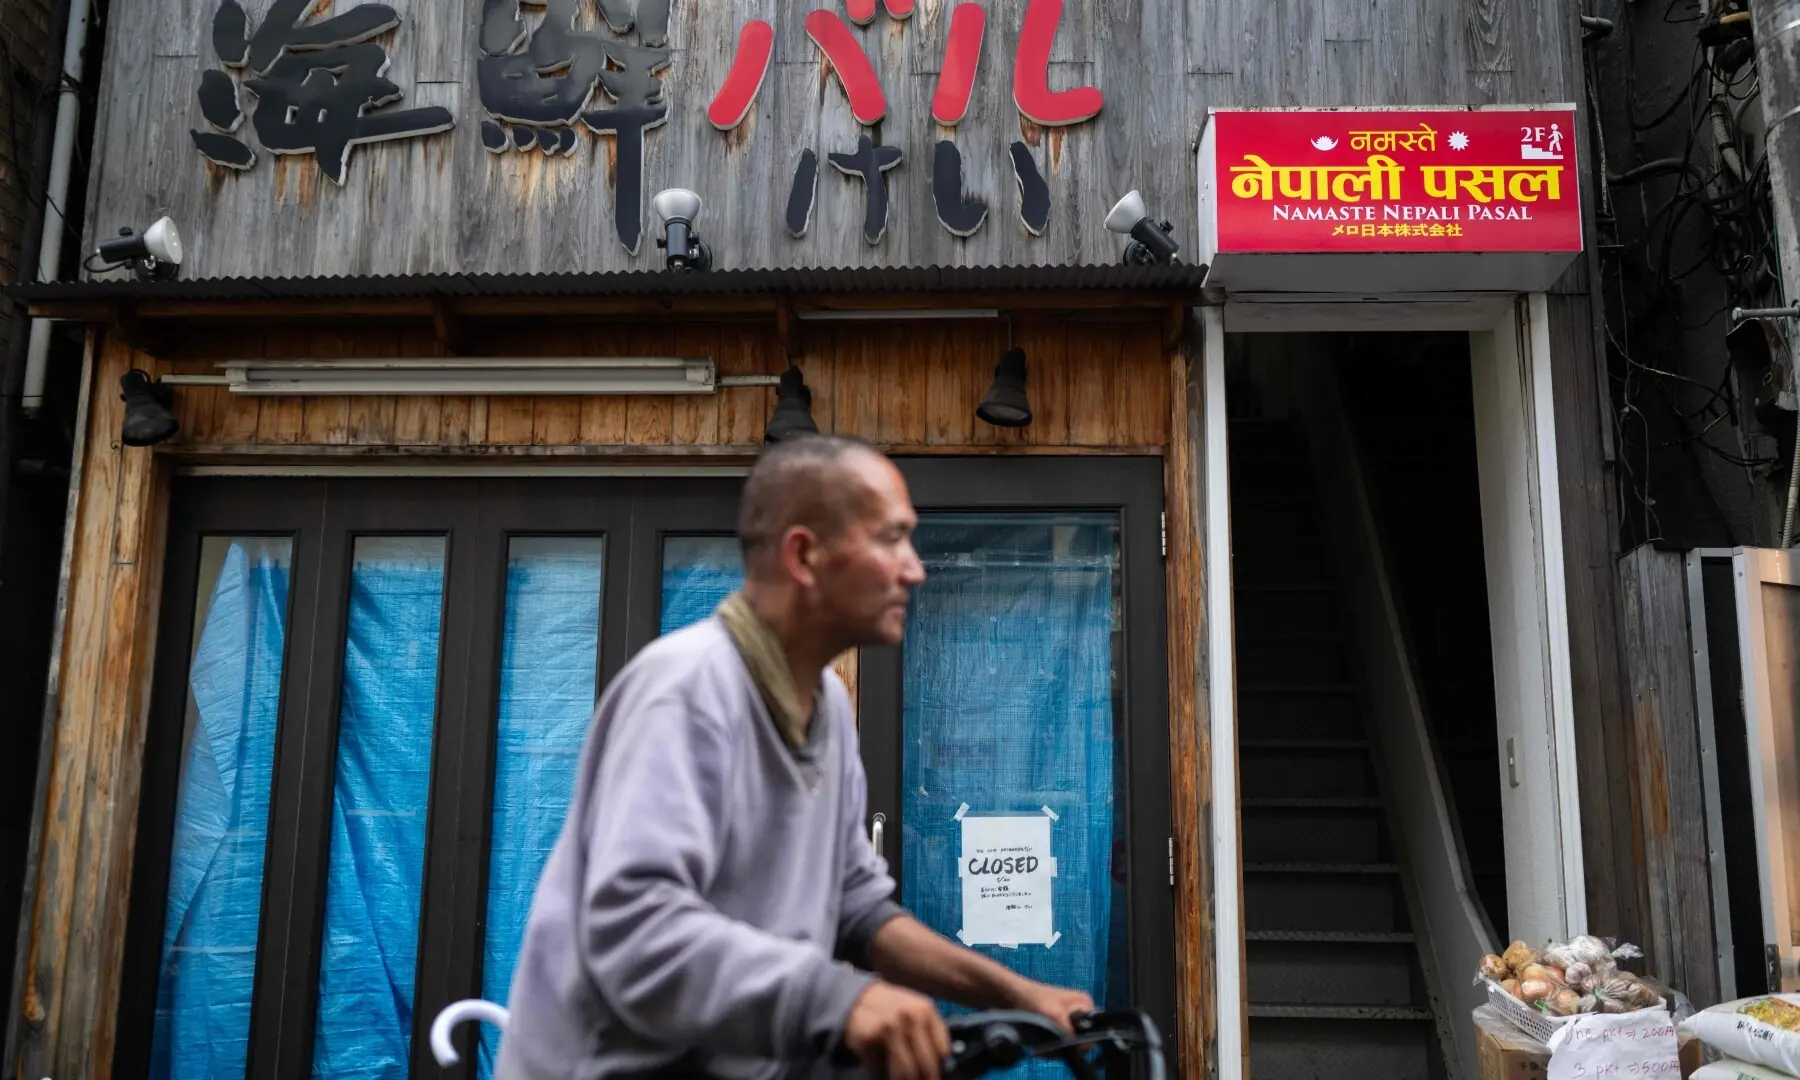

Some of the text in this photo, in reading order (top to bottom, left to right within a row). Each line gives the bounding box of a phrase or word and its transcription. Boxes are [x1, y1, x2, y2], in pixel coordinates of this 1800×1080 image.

[1348, 122, 1438, 152] नमस्ते
[1520, 126, 1546, 143] 2F
[1229, 154, 1565, 203] नेपाली पसल
[786, 134, 1052, 246] けい
[1272, 204, 1533, 221] NAMASTE NEPALI PASAL
[1331, 223, 1464, 237] メロ日本株式会社
[968, 855, 1039, 875] CLOSED
[1571, 1062, 1586, 1080] 3
